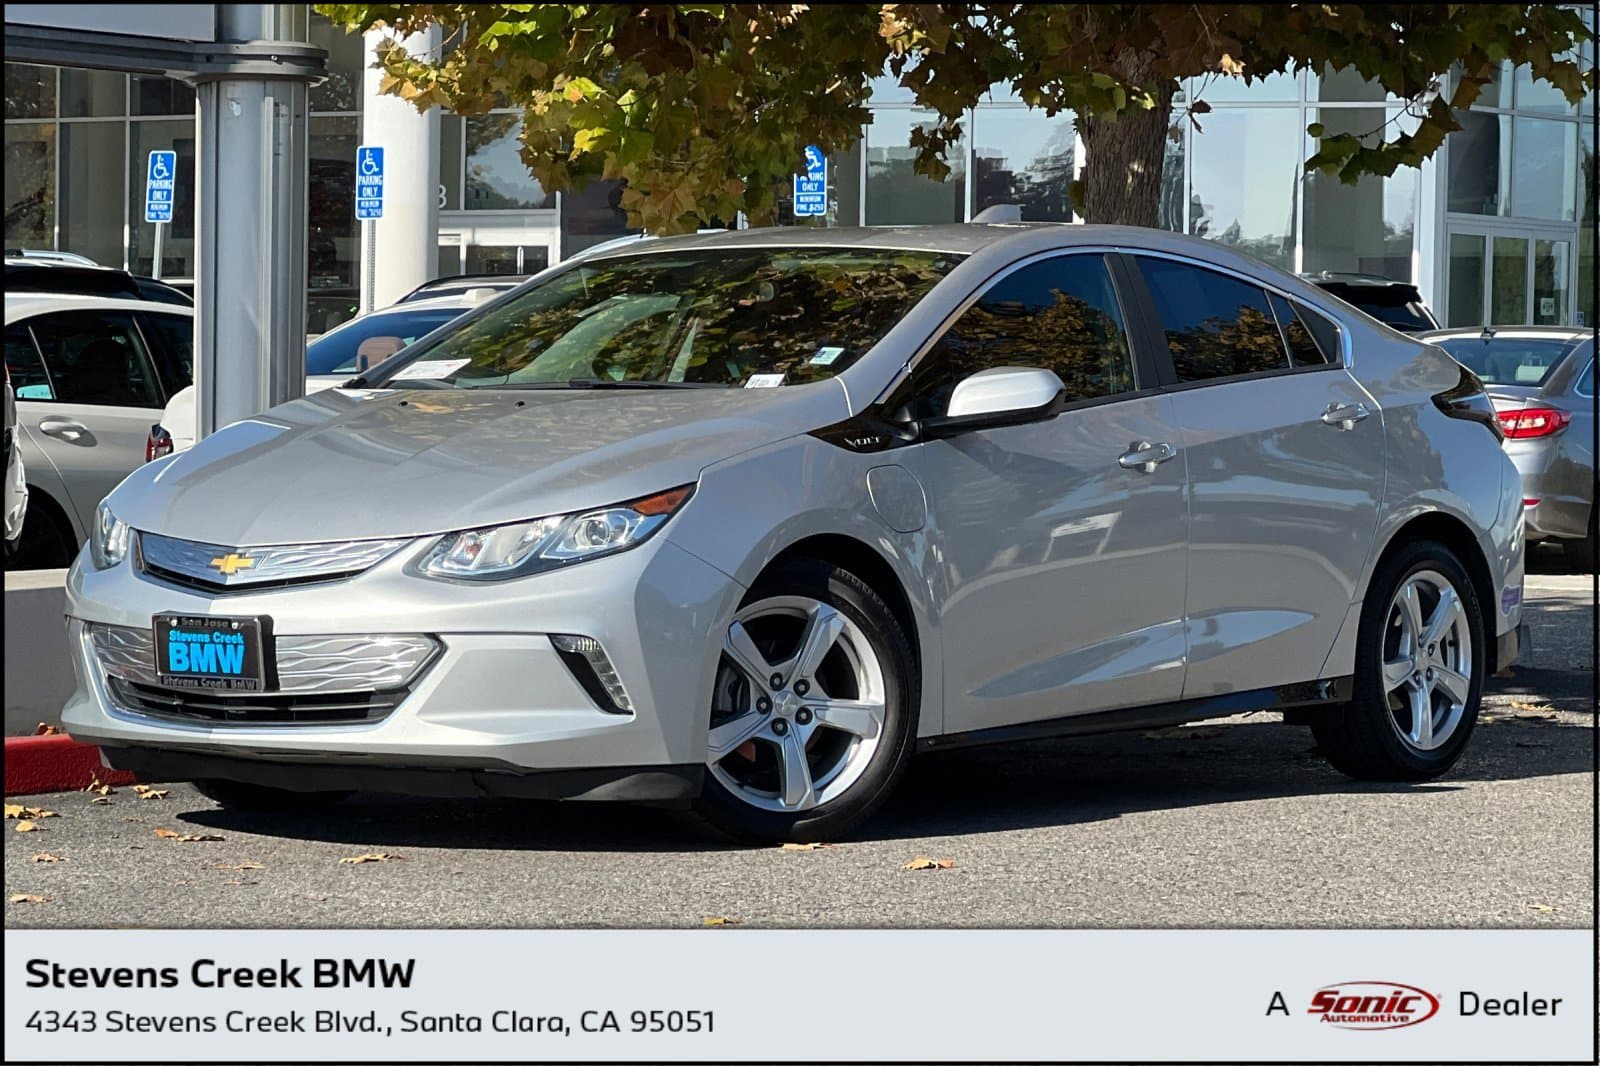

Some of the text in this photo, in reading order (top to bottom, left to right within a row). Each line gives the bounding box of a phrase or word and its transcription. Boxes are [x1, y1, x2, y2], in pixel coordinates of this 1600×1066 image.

[149, 179, 173, 189] PARKING
[358, 175, 383, 185] PARKING
[802, 182, 819, 191] ONLY
[152, 190, 167, 200] ONLY
[362, 187, 378, 197] ONLY
[844, 436, 880, 448] VOLT
[181, 617, 229, 628] San Jose
[169, 630, 244, 643] Stevens Creek
[169, 642, 245, 674] BMW
[162, 676, 256, 689] Stevens Creek BMW
